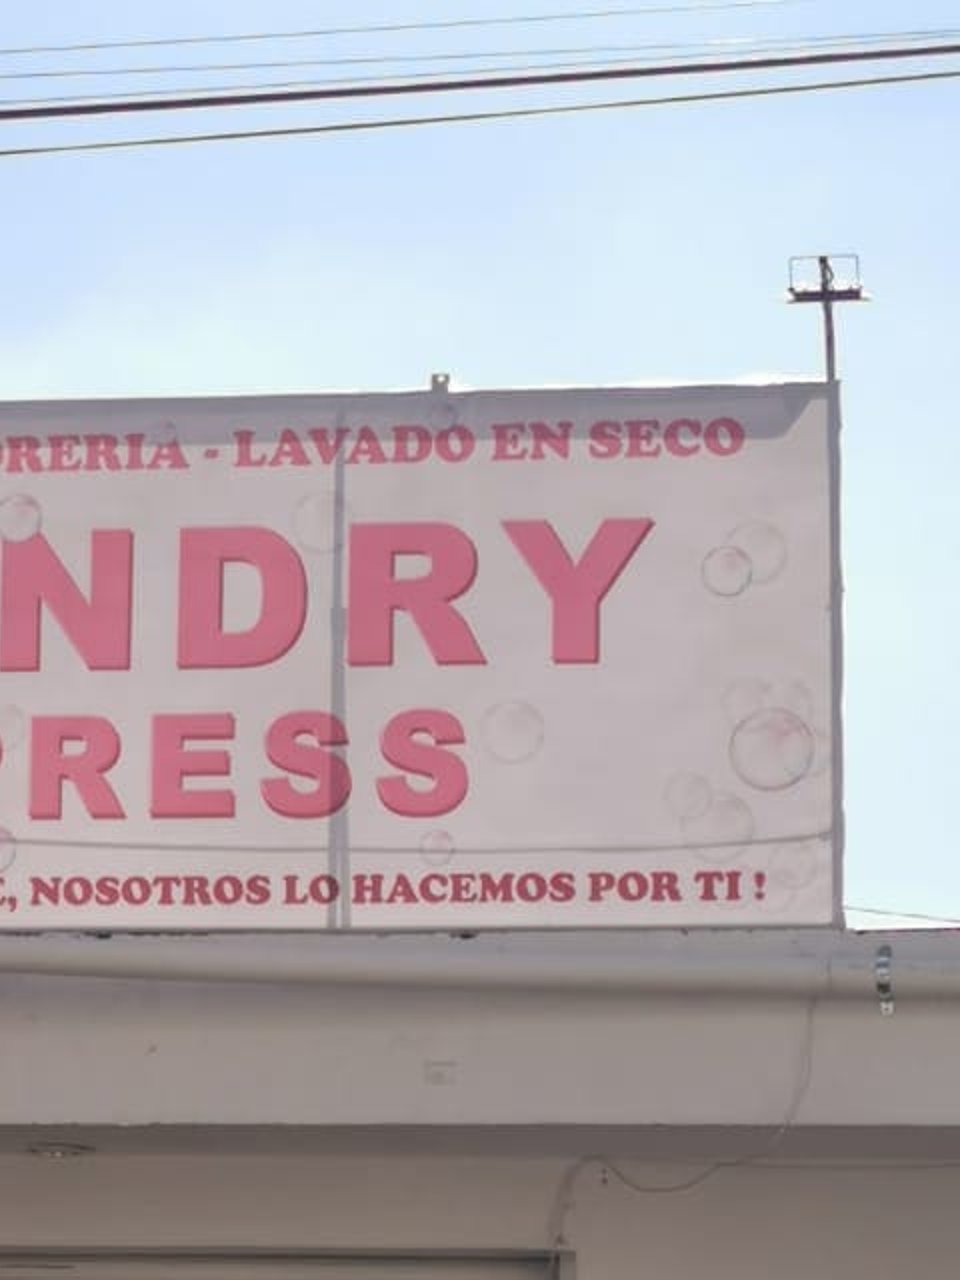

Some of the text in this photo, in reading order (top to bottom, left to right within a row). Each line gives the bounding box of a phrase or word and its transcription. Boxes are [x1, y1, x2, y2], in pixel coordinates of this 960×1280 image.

[233, 424, 476, 470] LAVADO
[492, 422, 571, 461] EN
[588, 420, 745, 459] SECO
[30, 875, 271, 907] NOSOTROS
[281, 875, 340, 906] LO
[351, 871, 575, 905] HACEMOS
[587, 870, 682, 903] POR
